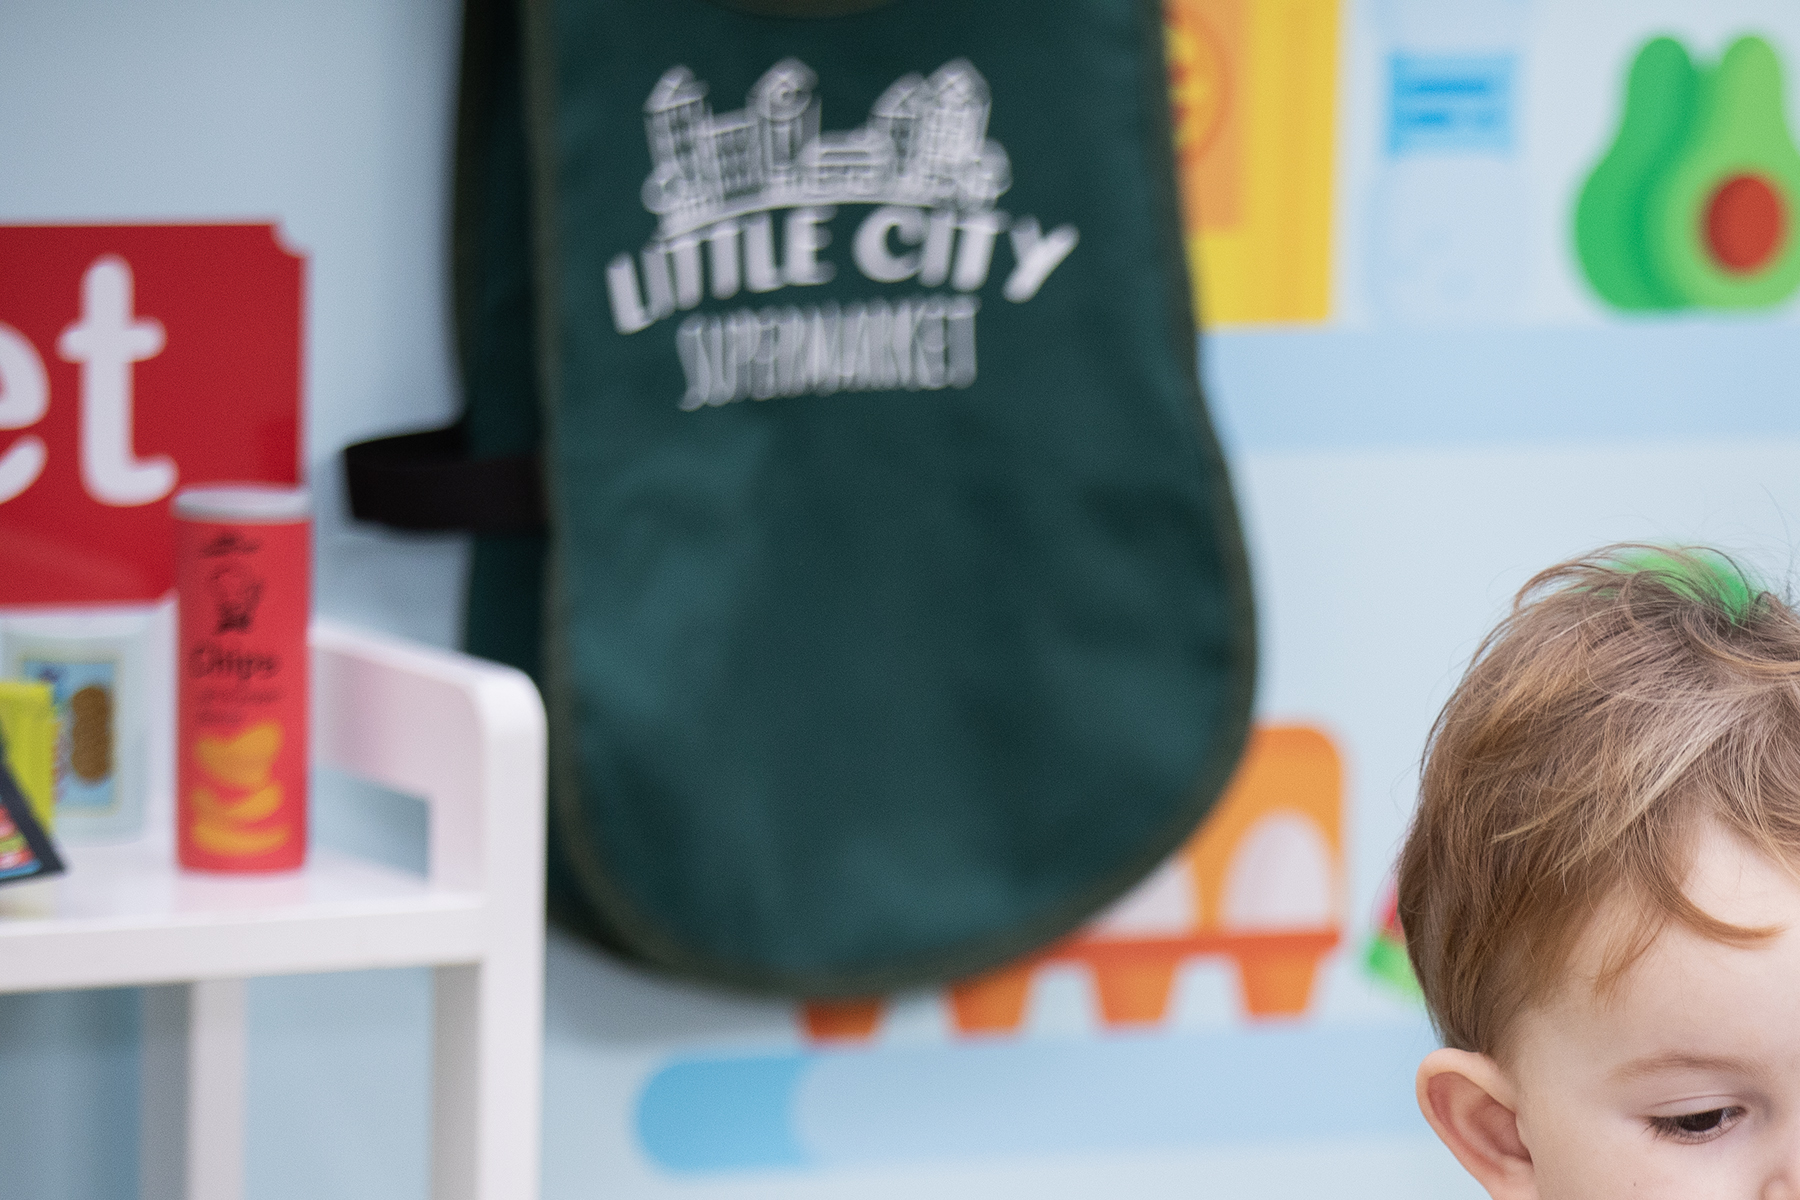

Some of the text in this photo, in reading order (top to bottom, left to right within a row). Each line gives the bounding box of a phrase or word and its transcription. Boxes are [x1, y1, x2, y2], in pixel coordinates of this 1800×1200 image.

[605, 203, 1080, 335] LITTLE CITY
[676, 295, 981, 411] SUPERMARKET
